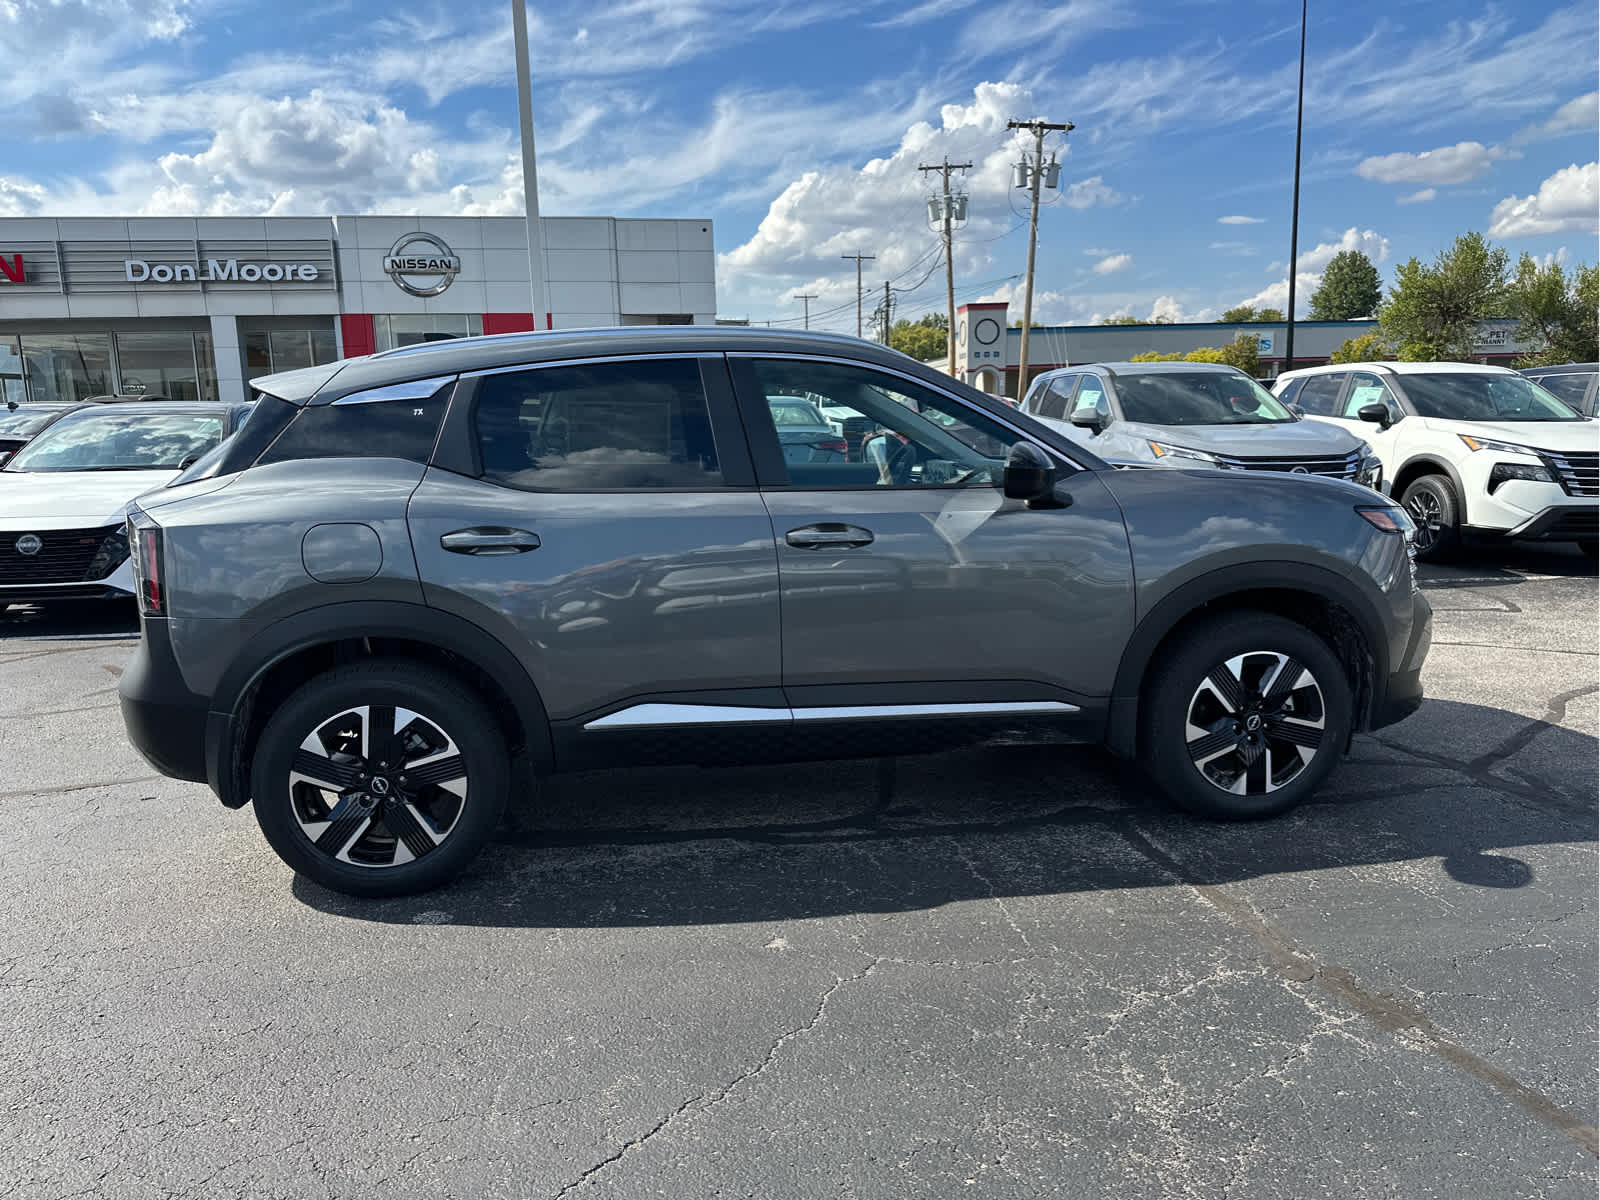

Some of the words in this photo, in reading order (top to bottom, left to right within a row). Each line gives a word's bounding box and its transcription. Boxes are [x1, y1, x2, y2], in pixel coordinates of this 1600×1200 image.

[125, 259, 196, 282] Don
[207, 258, 319, 282] Moore
[390, 259, 452, 269] NISSAN
